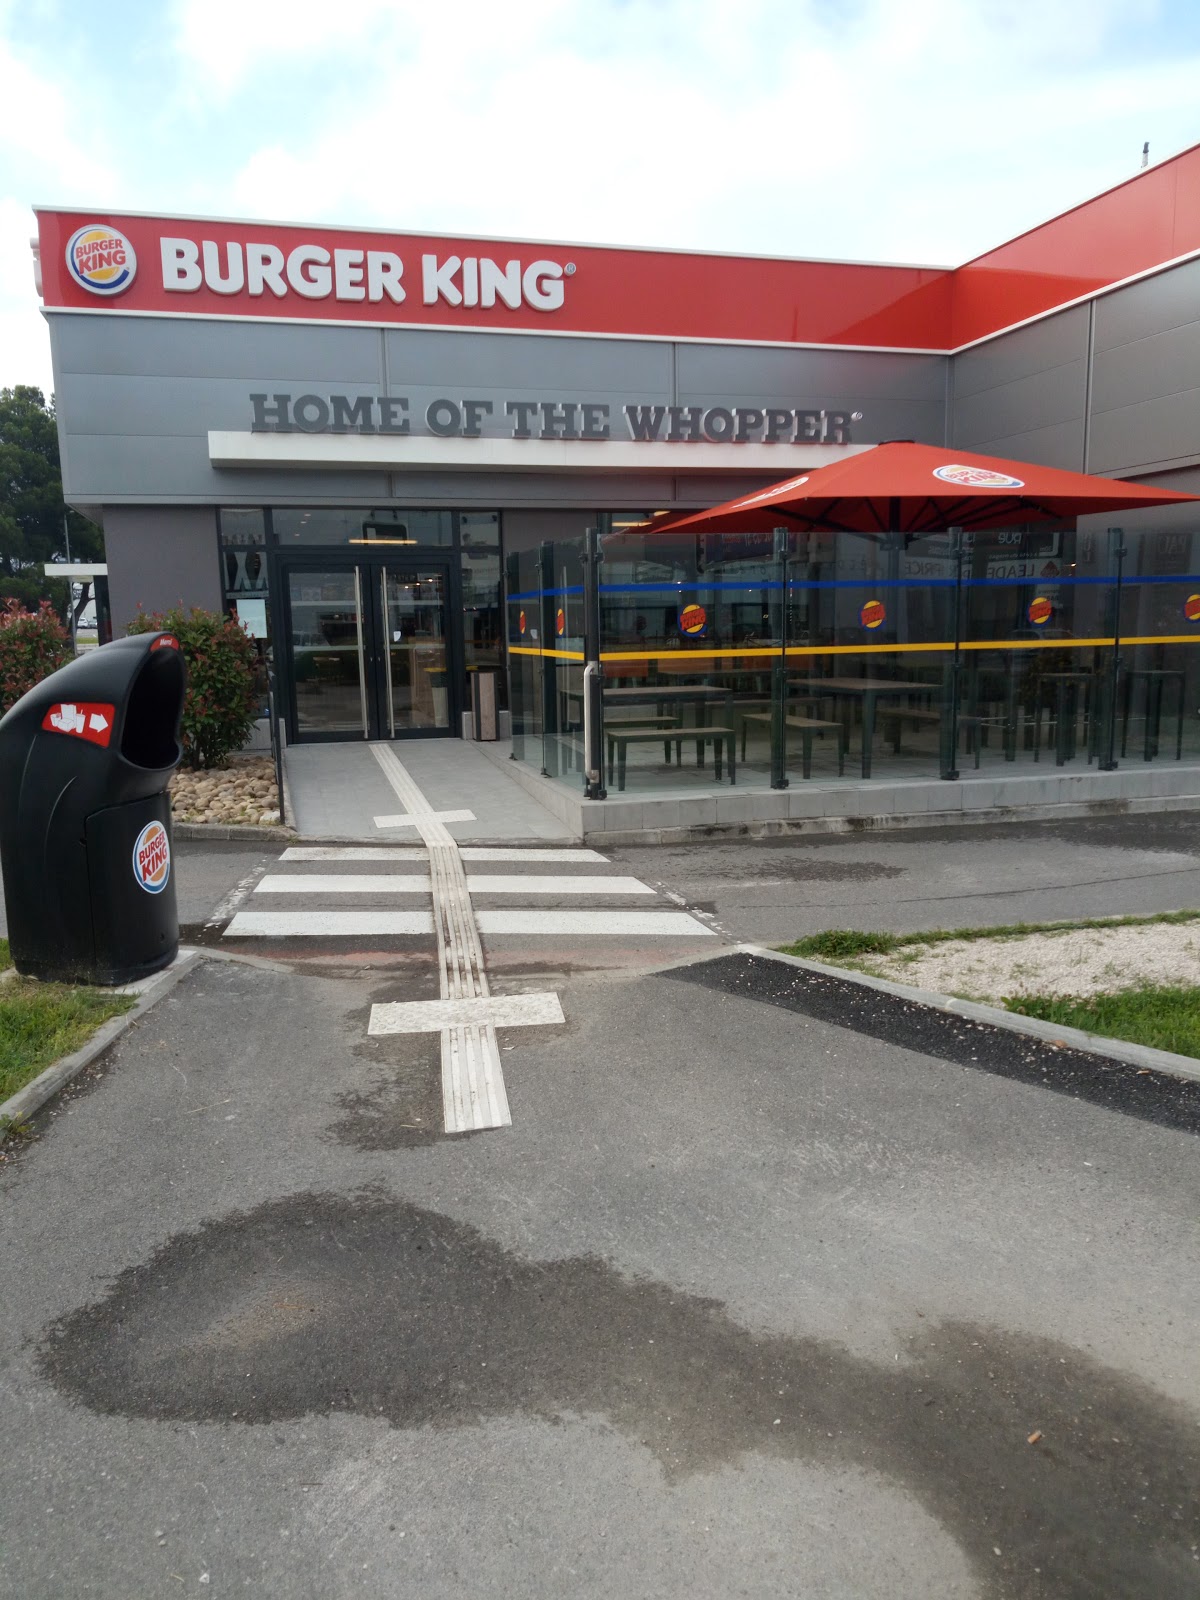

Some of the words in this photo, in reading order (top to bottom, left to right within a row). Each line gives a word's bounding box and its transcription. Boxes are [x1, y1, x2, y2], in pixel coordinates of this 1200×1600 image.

[75, 239, 123, 259] BURGER
[79, 250, 126, 275] KING
[159, 237, 406, 303] BURGER
[249, 394, 410, 433] HOME
[425, 399, 493, 438] OF
[504, 402, 610, 440] THE
[138, 831, 165, 866] BURGER
[141, 842, 168, 882] KING
